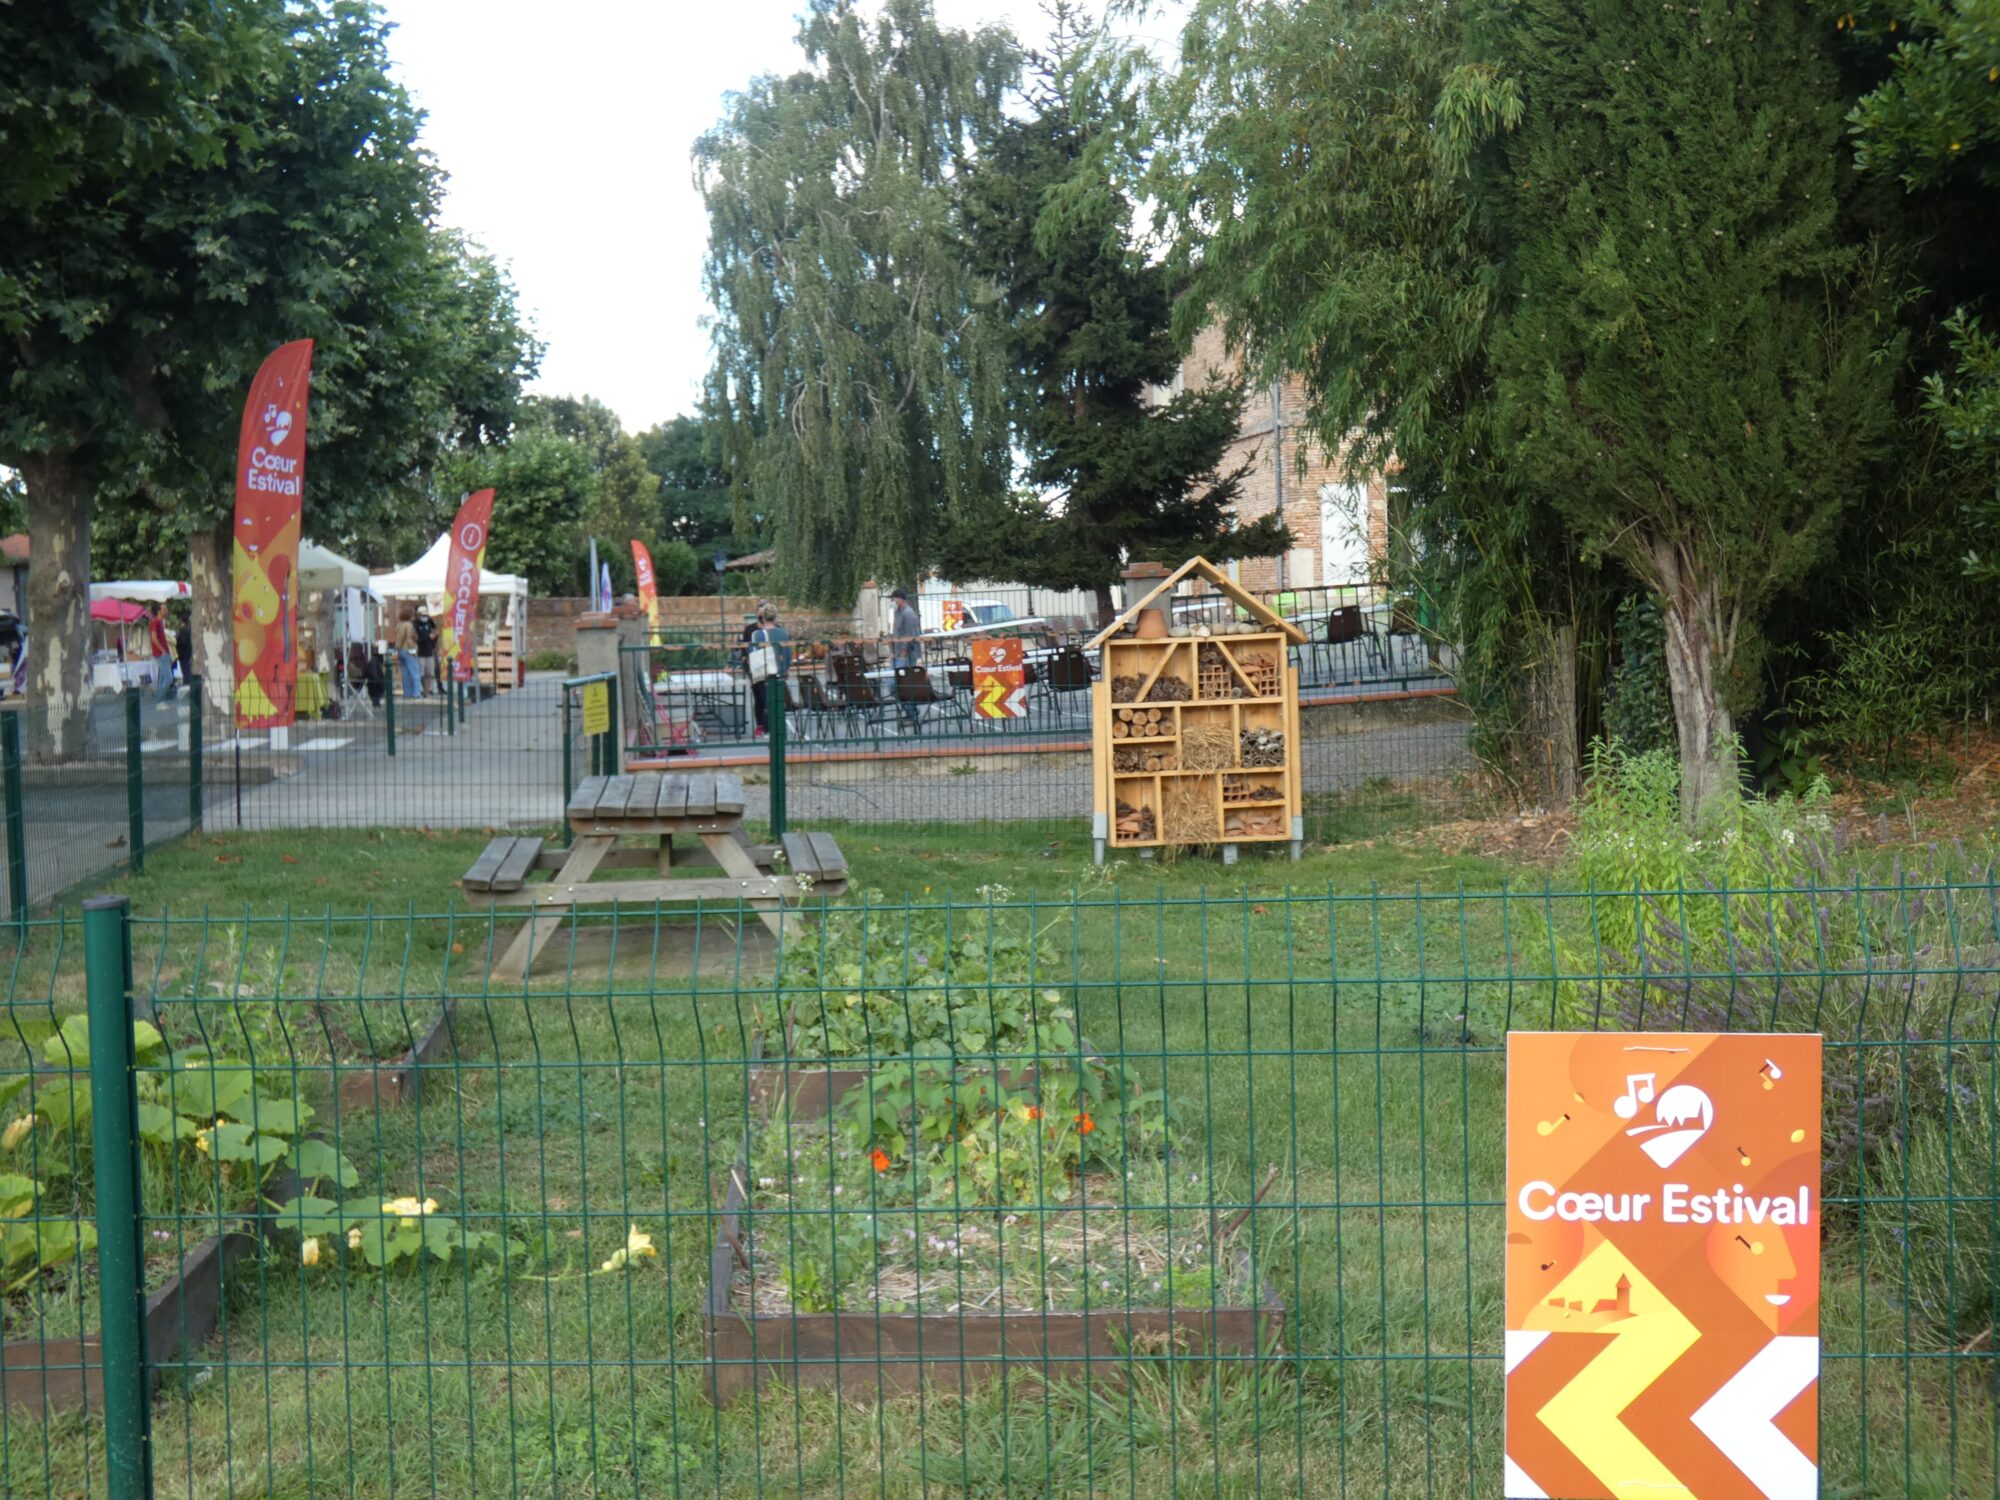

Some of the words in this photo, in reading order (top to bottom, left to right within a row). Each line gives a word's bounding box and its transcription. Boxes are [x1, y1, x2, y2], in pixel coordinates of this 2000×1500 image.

[252, 447, 297, 473] Cœur
[248, 468, 300, 496] Estival
[454, 557, 473, 644] ACCUEIL
[1518, 1180, 1651, 1221] Cœur
[1663, 1183, 1809, 1225] Estival
